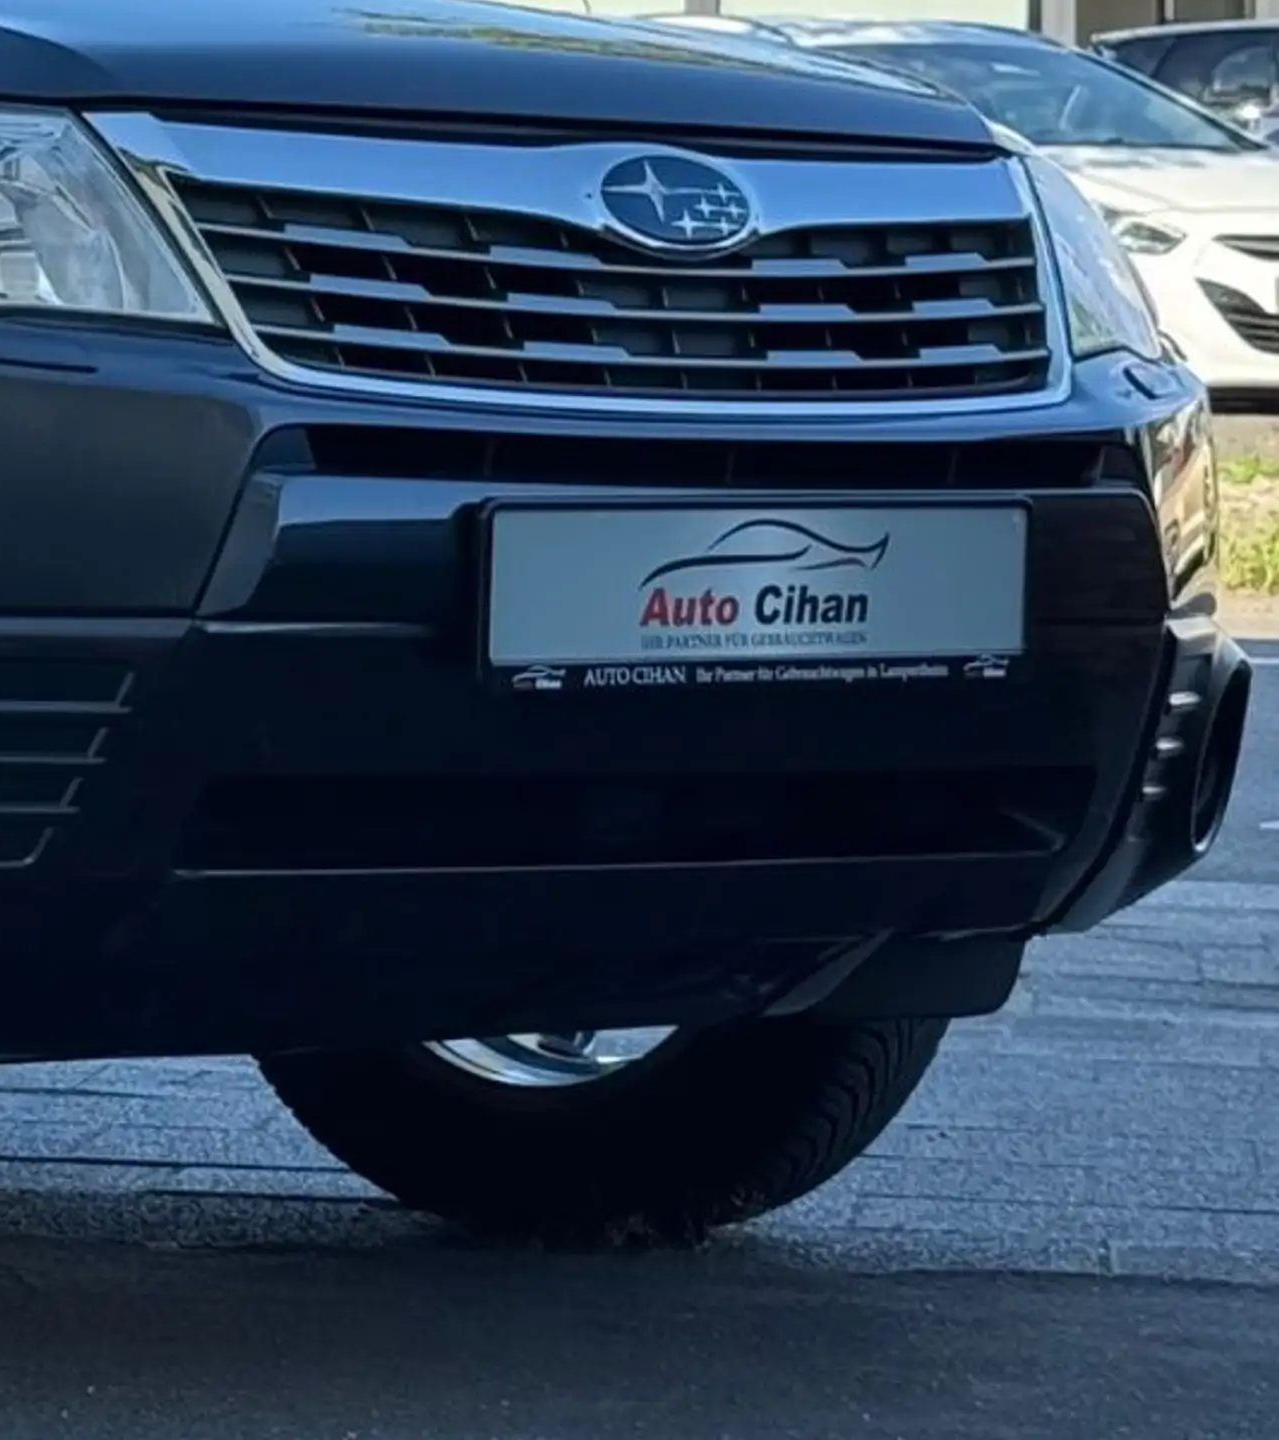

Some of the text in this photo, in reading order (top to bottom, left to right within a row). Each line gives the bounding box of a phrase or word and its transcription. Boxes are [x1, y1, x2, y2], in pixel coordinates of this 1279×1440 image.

[639, 584, 869, 627] Auto Cihan
[583, 666, 630, 686] AUTO
[632, 665, 687, 685] CIHAN
